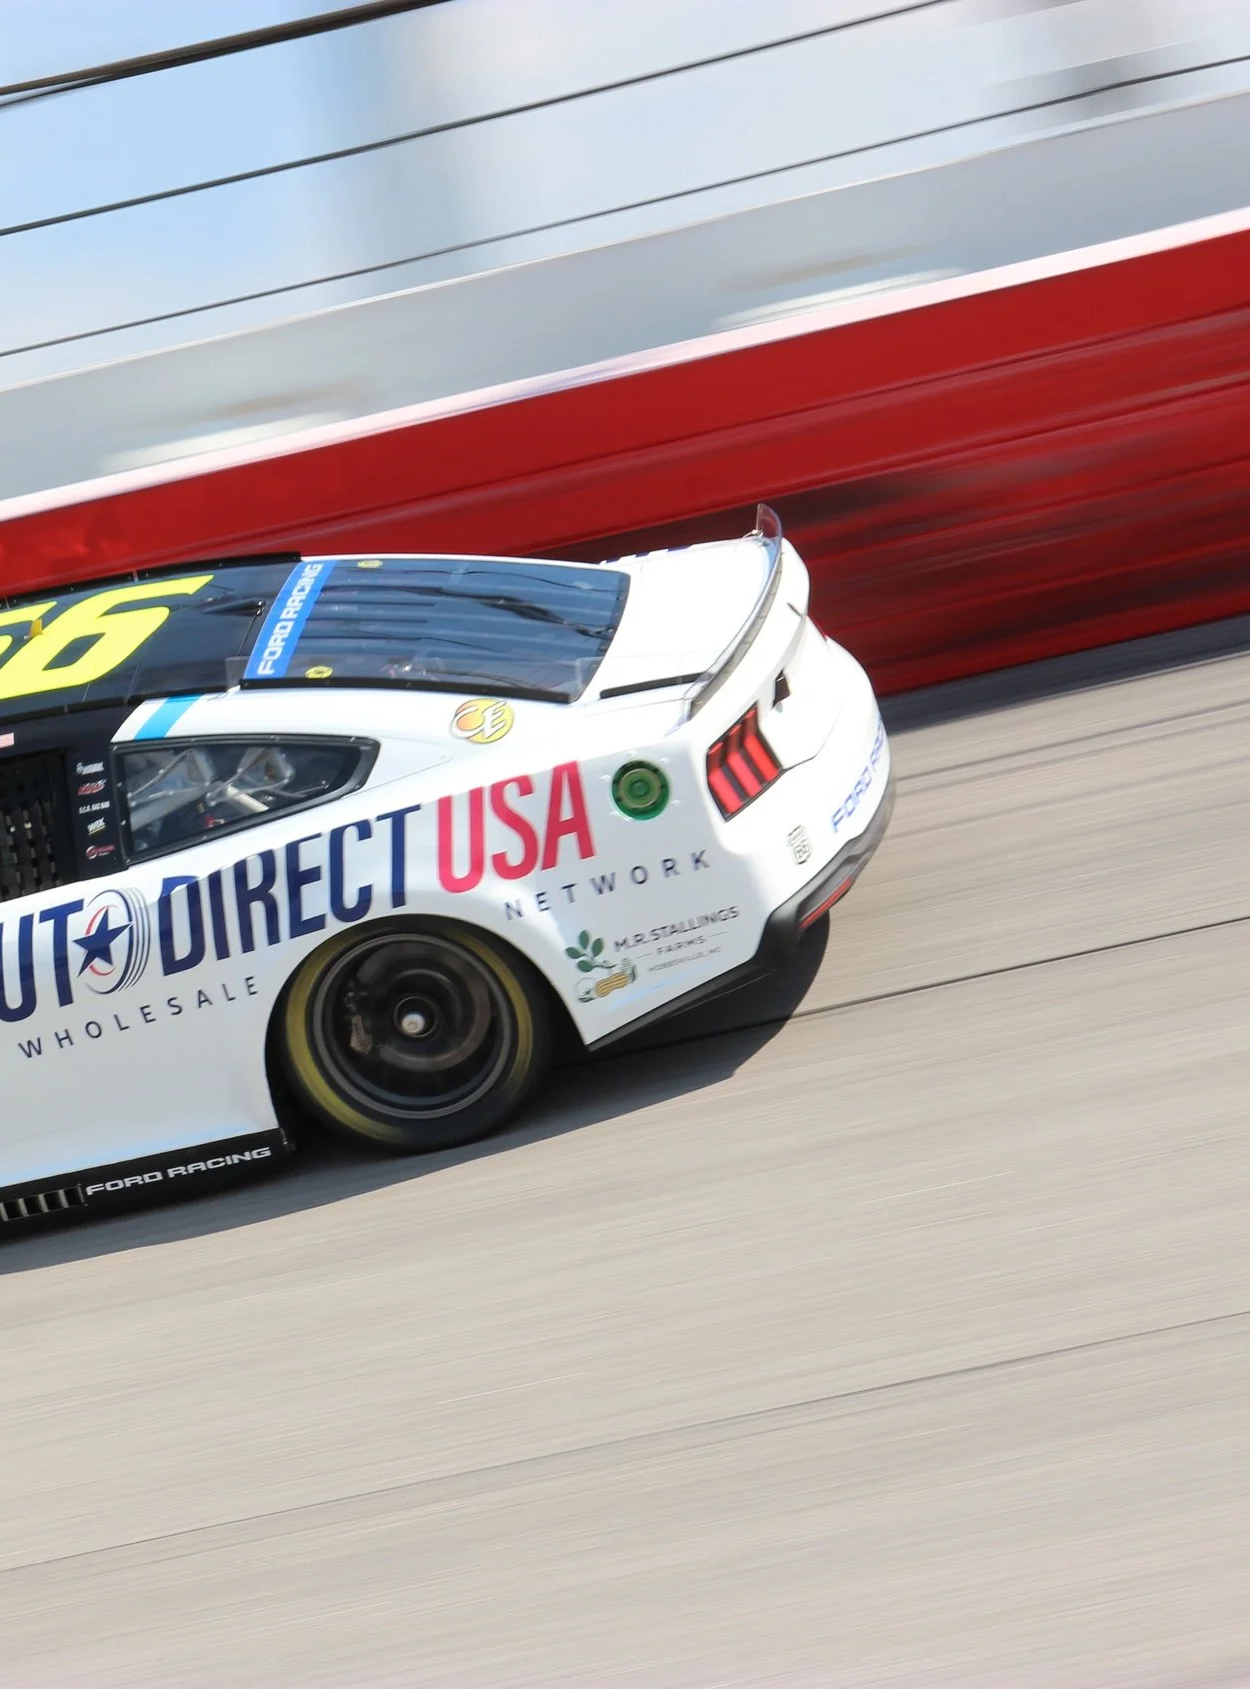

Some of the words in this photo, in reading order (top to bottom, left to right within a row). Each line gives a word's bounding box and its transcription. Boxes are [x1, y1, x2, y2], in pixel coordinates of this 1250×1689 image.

[257, 620, 295, 676] FORD
[280, 563, 325, 620] RACING
[158, 803, 422, 977] DIRECT
[437, 759, 597, 894] USA
[503, 849, 711, 921] NETWORK
[655, 935, 706, 956] FARMS
[18, 975, 259, 1059] WHOLESALE
[86, 1171, 163, 1196] FORD
[166, 1146, 272, 1178] RACING
